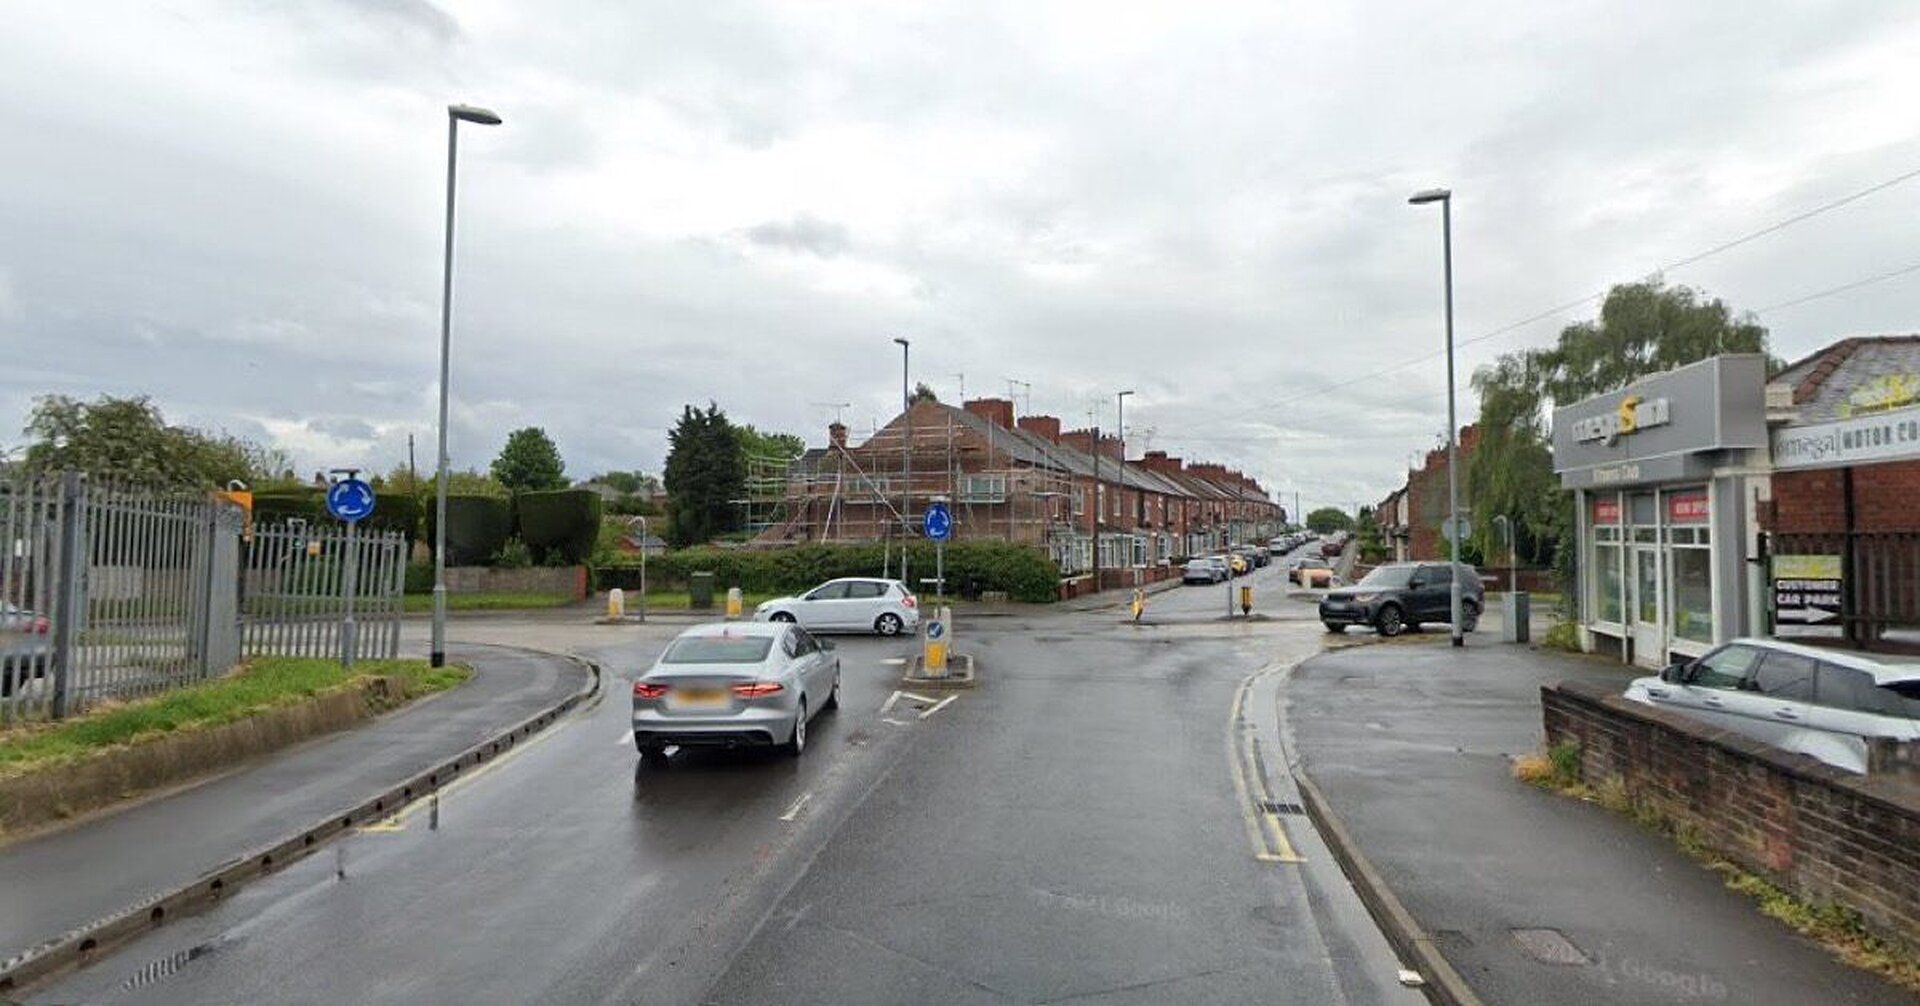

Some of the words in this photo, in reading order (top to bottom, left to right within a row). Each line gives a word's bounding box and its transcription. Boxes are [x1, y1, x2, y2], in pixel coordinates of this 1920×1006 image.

[1842, 425, 1891, 450] MOTOR
[1777, 580, 1839, 591] CUSTOMER
[1777, 593, 1801, 605] CAR
[1804, 593, 1841, 606] PARK
